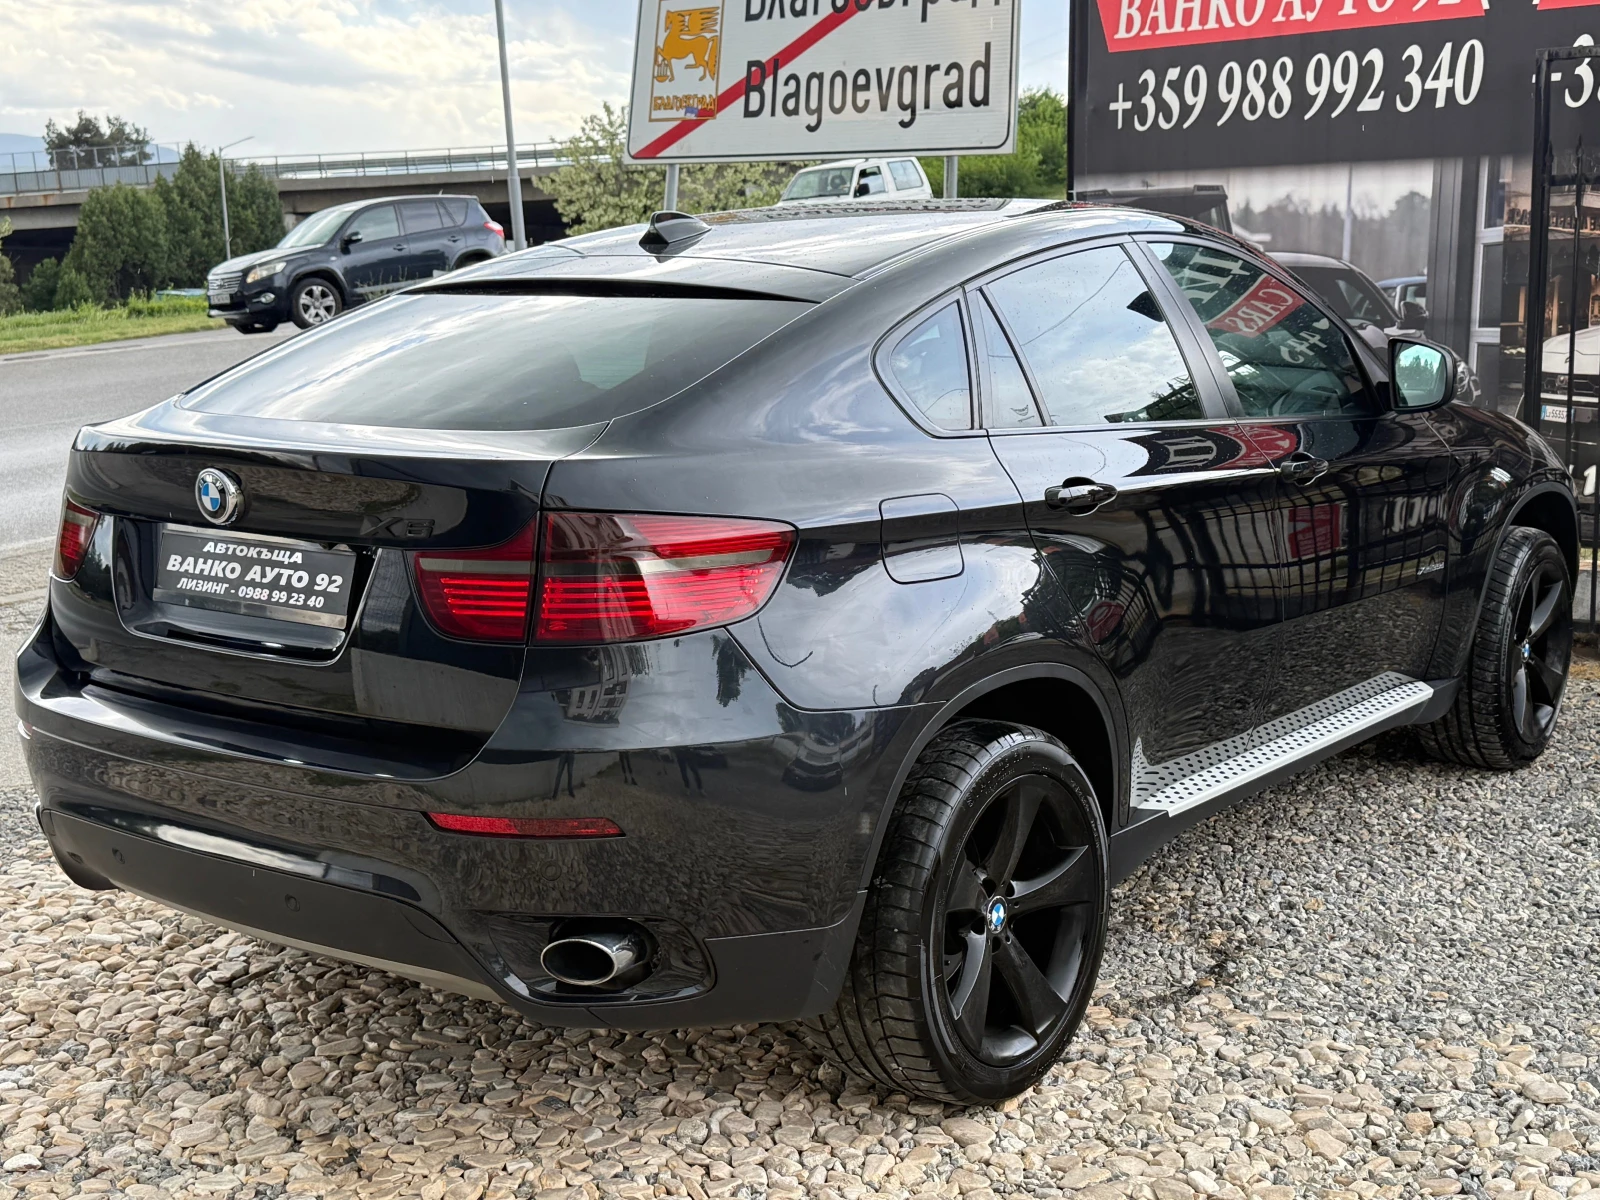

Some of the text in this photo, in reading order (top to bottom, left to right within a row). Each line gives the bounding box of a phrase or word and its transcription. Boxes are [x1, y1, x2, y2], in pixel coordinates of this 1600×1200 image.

[743, 41, 991, 133] Blagoevgrad
[1109, 63, 1208, 132] +359
[1217, 56, 1293, 127] 988
[1304, 47, 1385, 121] 992
[1395, 38, 1485, 113] 340
[203, 541, 303, 564] АВТОКЪЩА
[166, 554, 343, 593] ВАНКО АУТО 92
[177, 577, 229, 595] ЛИЗИНГ
[237, 585, 270, 601] 0988
[270, 589, 287, 603] 99
[288, 591, 305, 606] 23
[306, 594, 325, 609] 40
